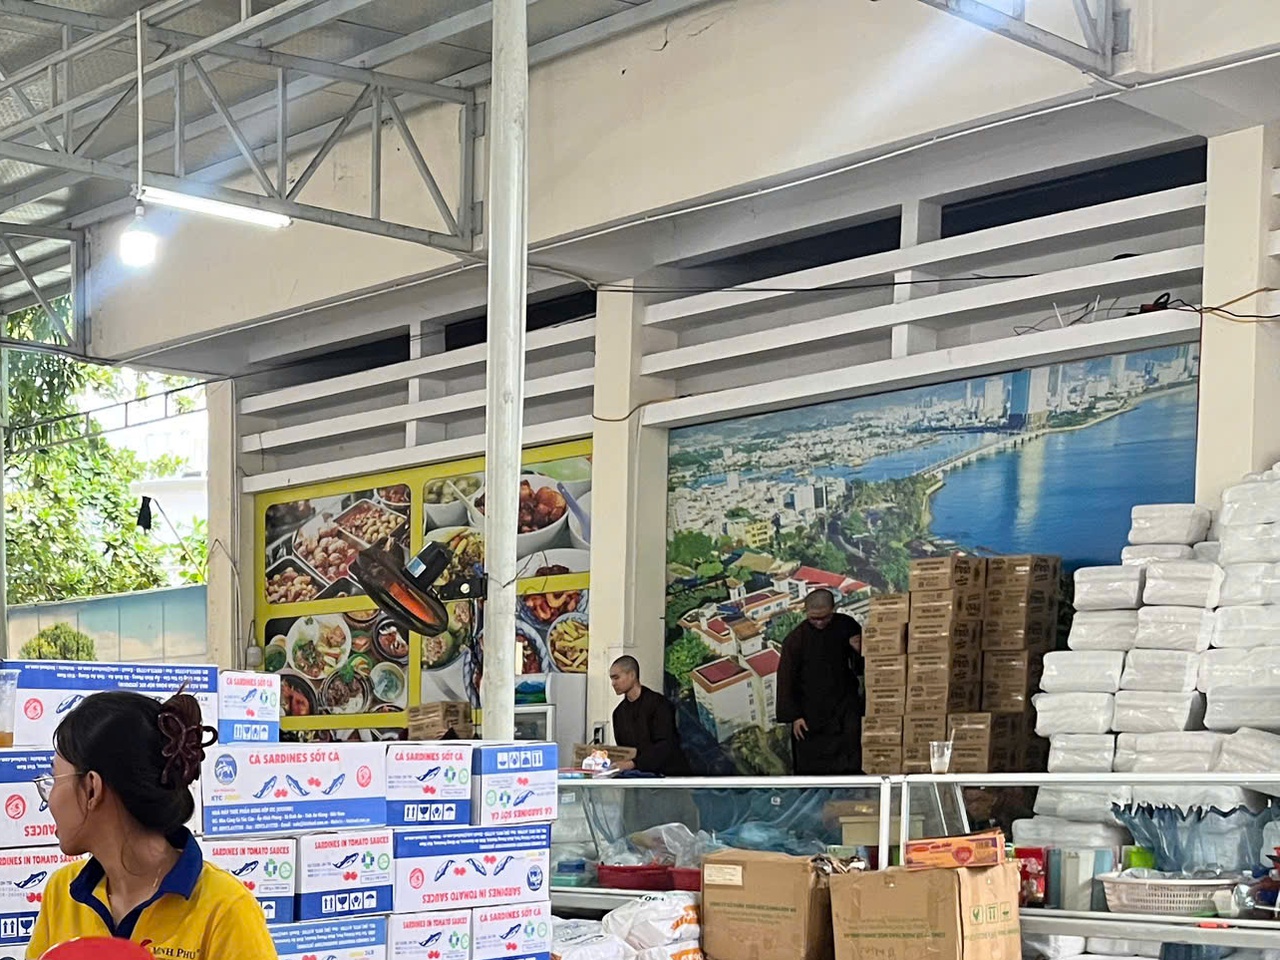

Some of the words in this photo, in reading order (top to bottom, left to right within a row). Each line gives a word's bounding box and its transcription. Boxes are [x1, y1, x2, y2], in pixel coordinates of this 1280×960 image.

[263, 753, 308, 764] SARDINES
[406, 752, 440, 761] SARDINES
[24, 824, 57, 837] AUCES
[314, 839, 340, 849] SARDINES
[348, 837, 369, 847] TOMATO
[370, 836, 389, 844] SAUCES
[212, 847, 238, 856] SARDINES
[246, 847, 269, 855] TOMATO
[269, 846, 290, 855] SAUCES
[23, 855, 31, 865] IN
[32, 854, 58, 864] TOMATO
[450, 890, 478, 901] TOMATO
[488, 886, 521, 898] SARDINES
[422, 892, 449, 904] SAUCES
[489, 908, 519, 920] SARDINES
